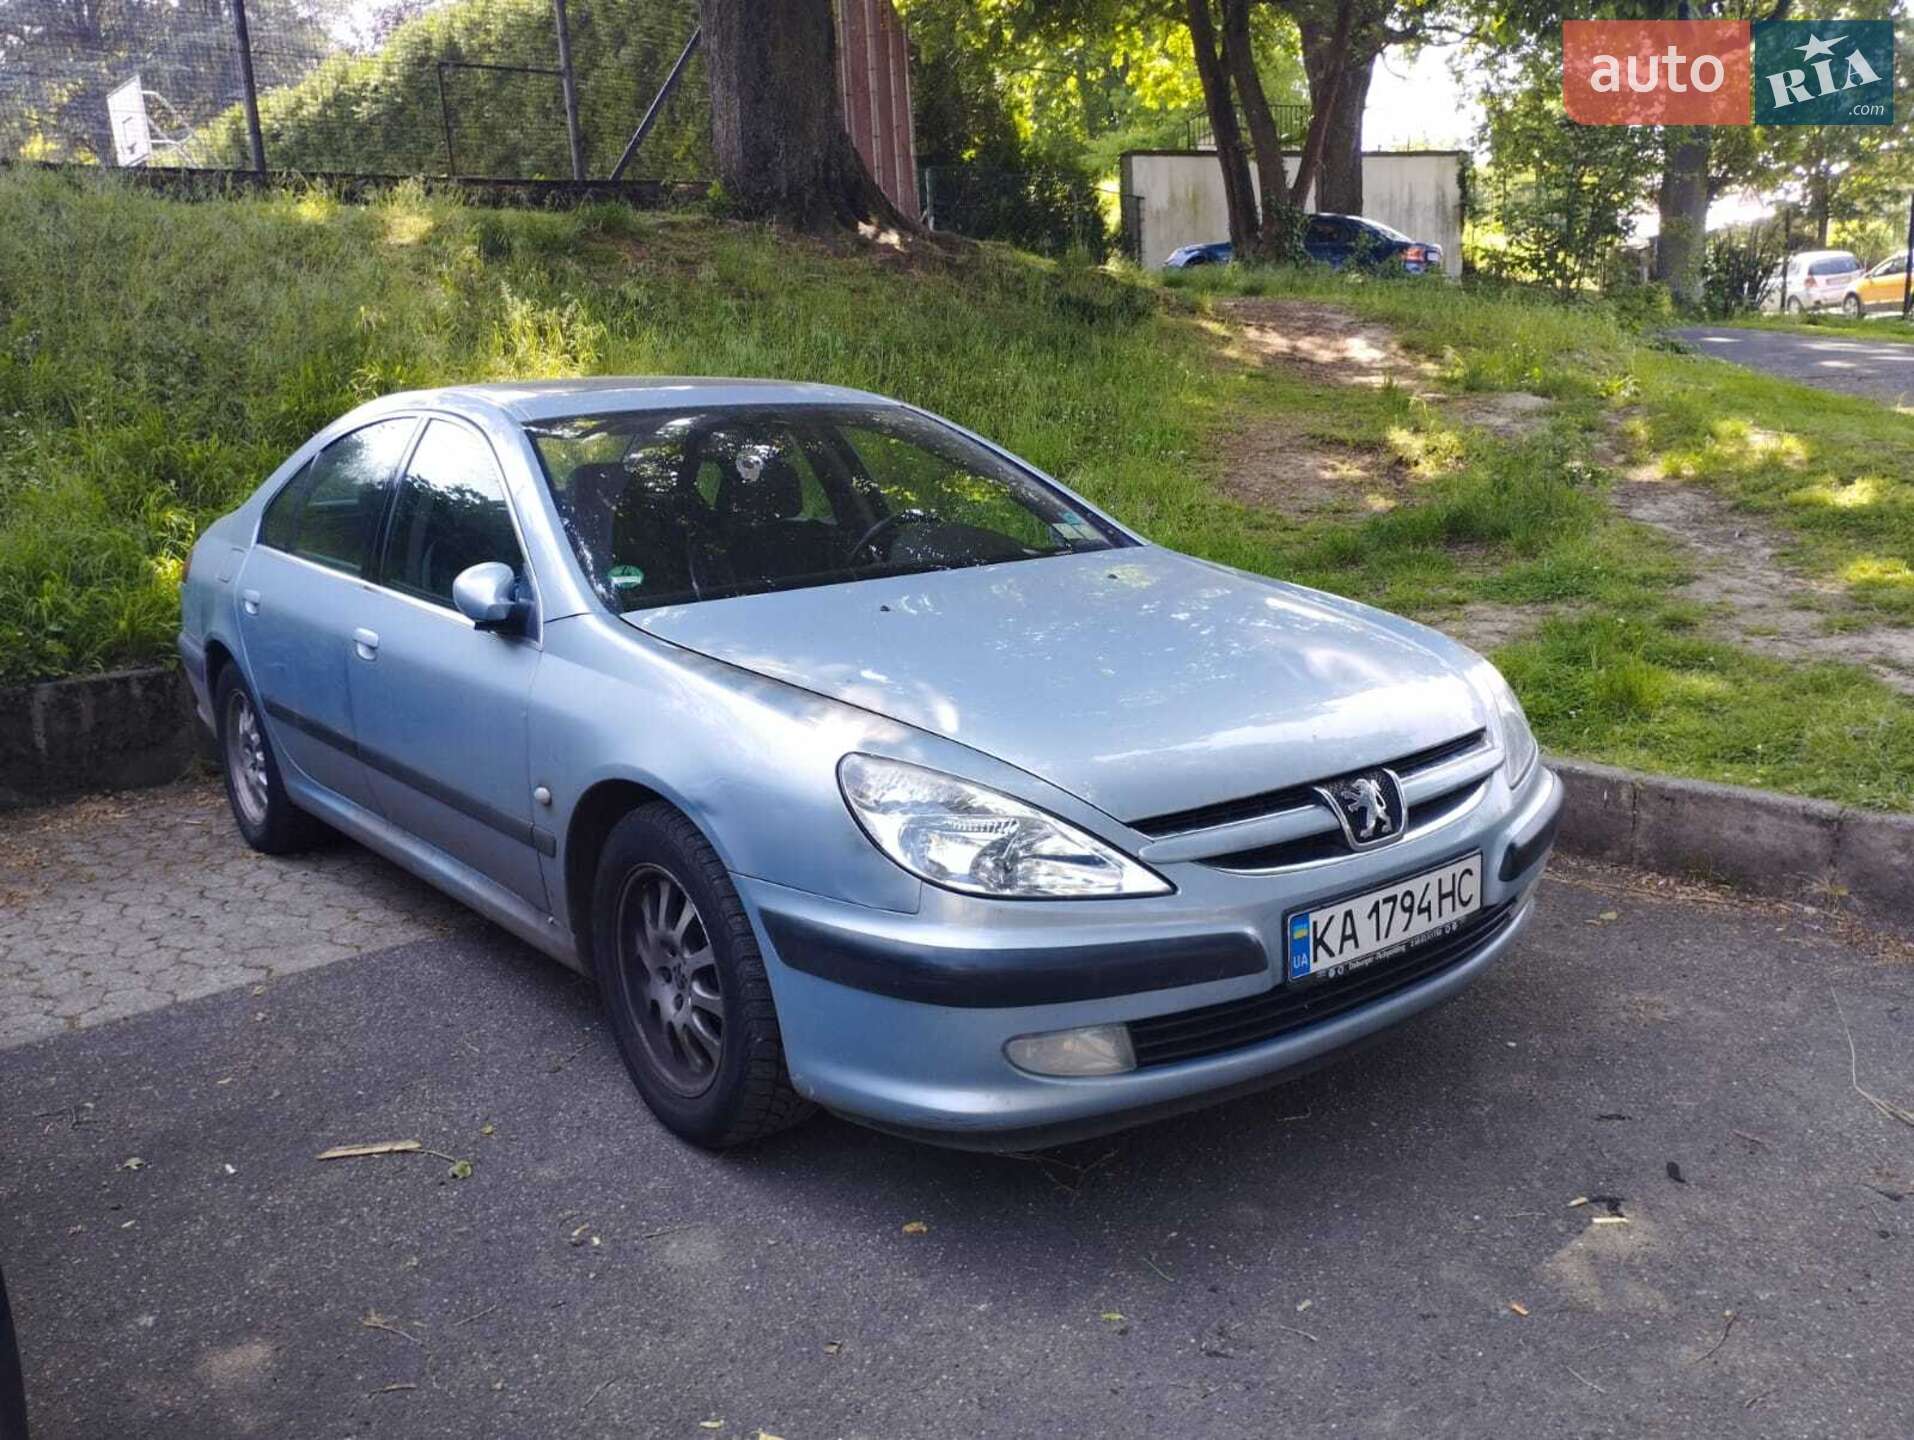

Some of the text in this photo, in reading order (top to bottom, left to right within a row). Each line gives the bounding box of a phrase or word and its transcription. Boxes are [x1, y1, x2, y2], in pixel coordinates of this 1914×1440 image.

[1312, 868, 1474, 963] KA 1794 HC
[1293, 954, 1309, 969] UA
